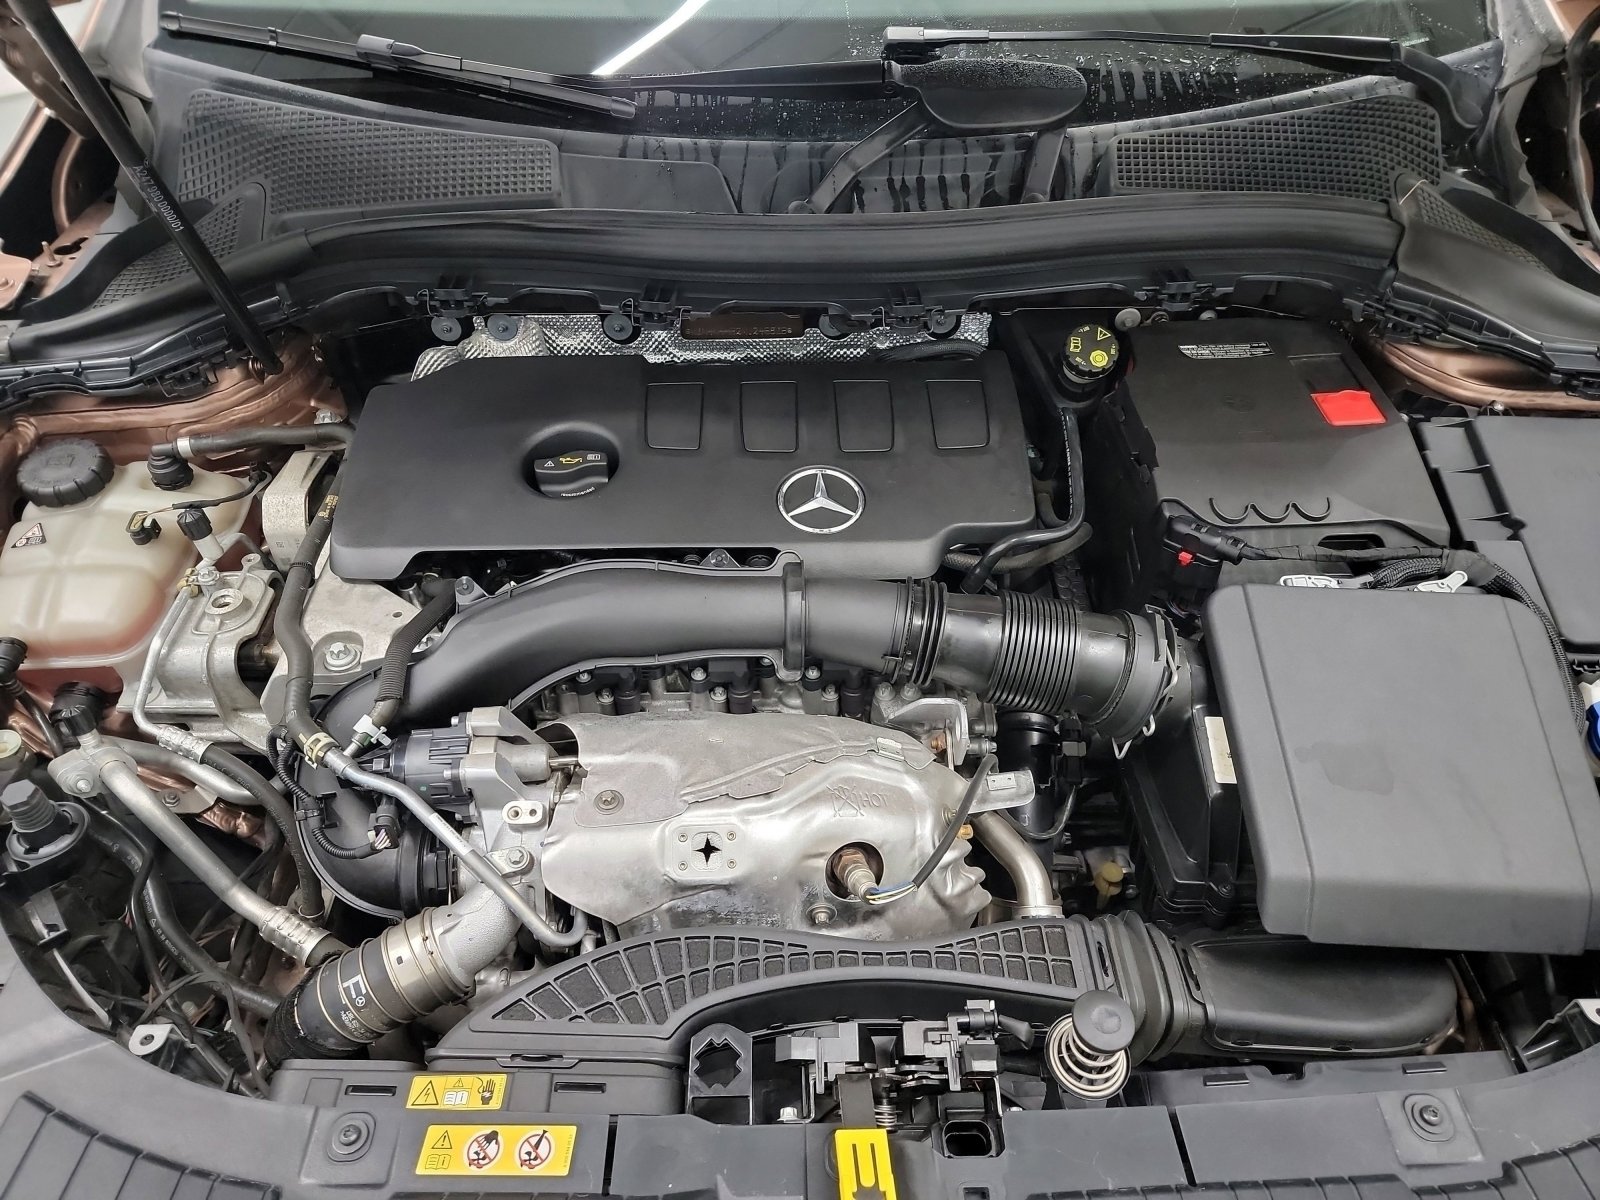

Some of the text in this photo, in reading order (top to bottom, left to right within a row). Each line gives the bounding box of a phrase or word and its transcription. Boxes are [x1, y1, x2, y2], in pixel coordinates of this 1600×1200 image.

[133, 165, 184, 232] A247 980 0000/01
